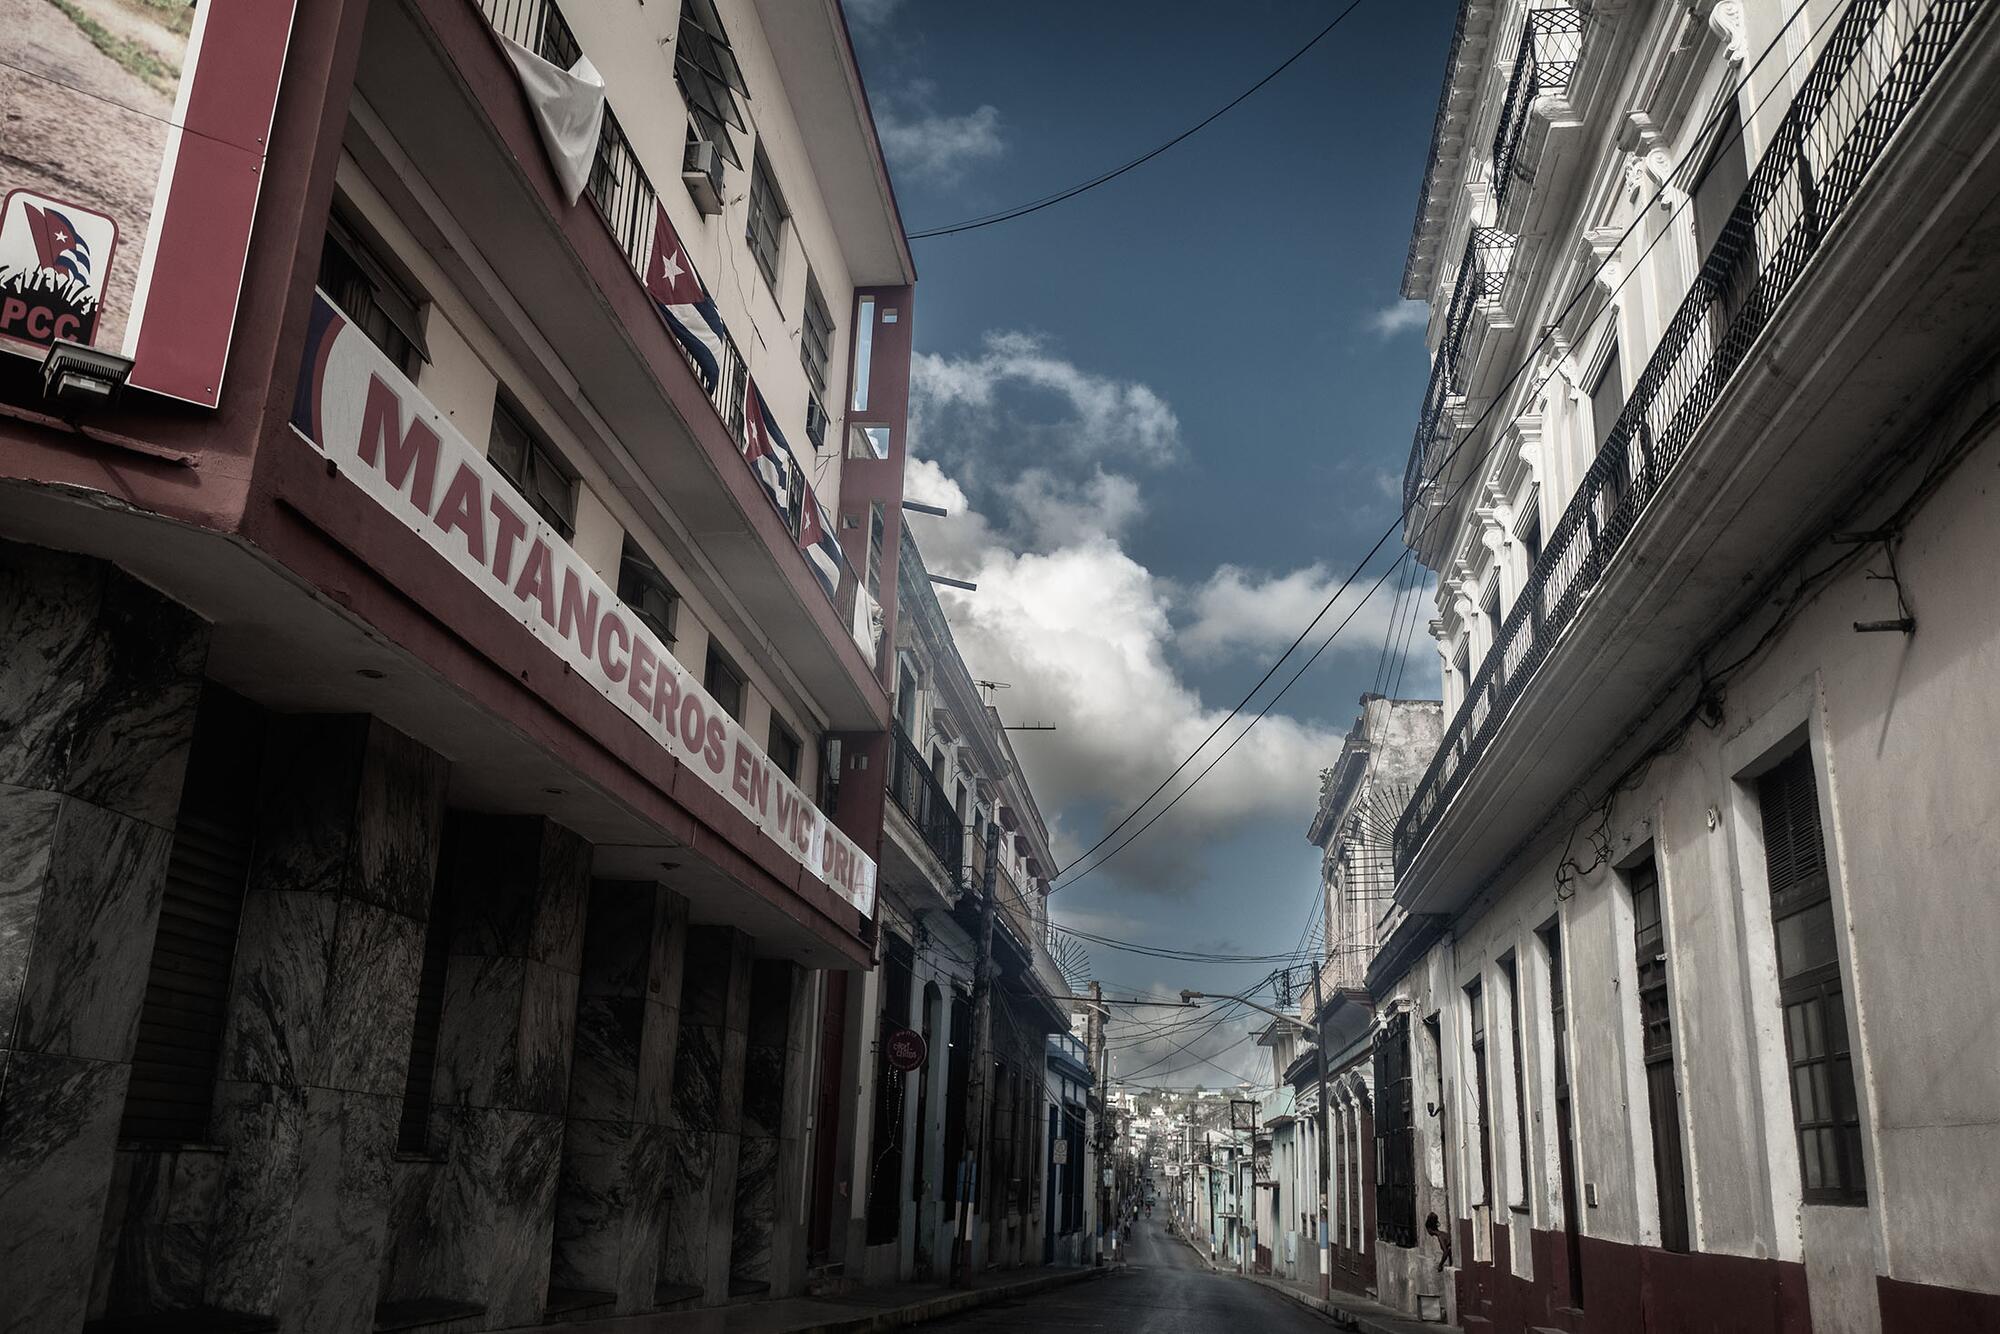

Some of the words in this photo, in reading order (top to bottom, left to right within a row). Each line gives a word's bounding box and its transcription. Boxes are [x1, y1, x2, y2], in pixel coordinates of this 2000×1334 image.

[0, 297, 80, 342] PCC
[357, 371, 727, 775] MATANCEROS
[732, 740, 770, 817] EN
[776, 779, 865, 901] VICORIA
